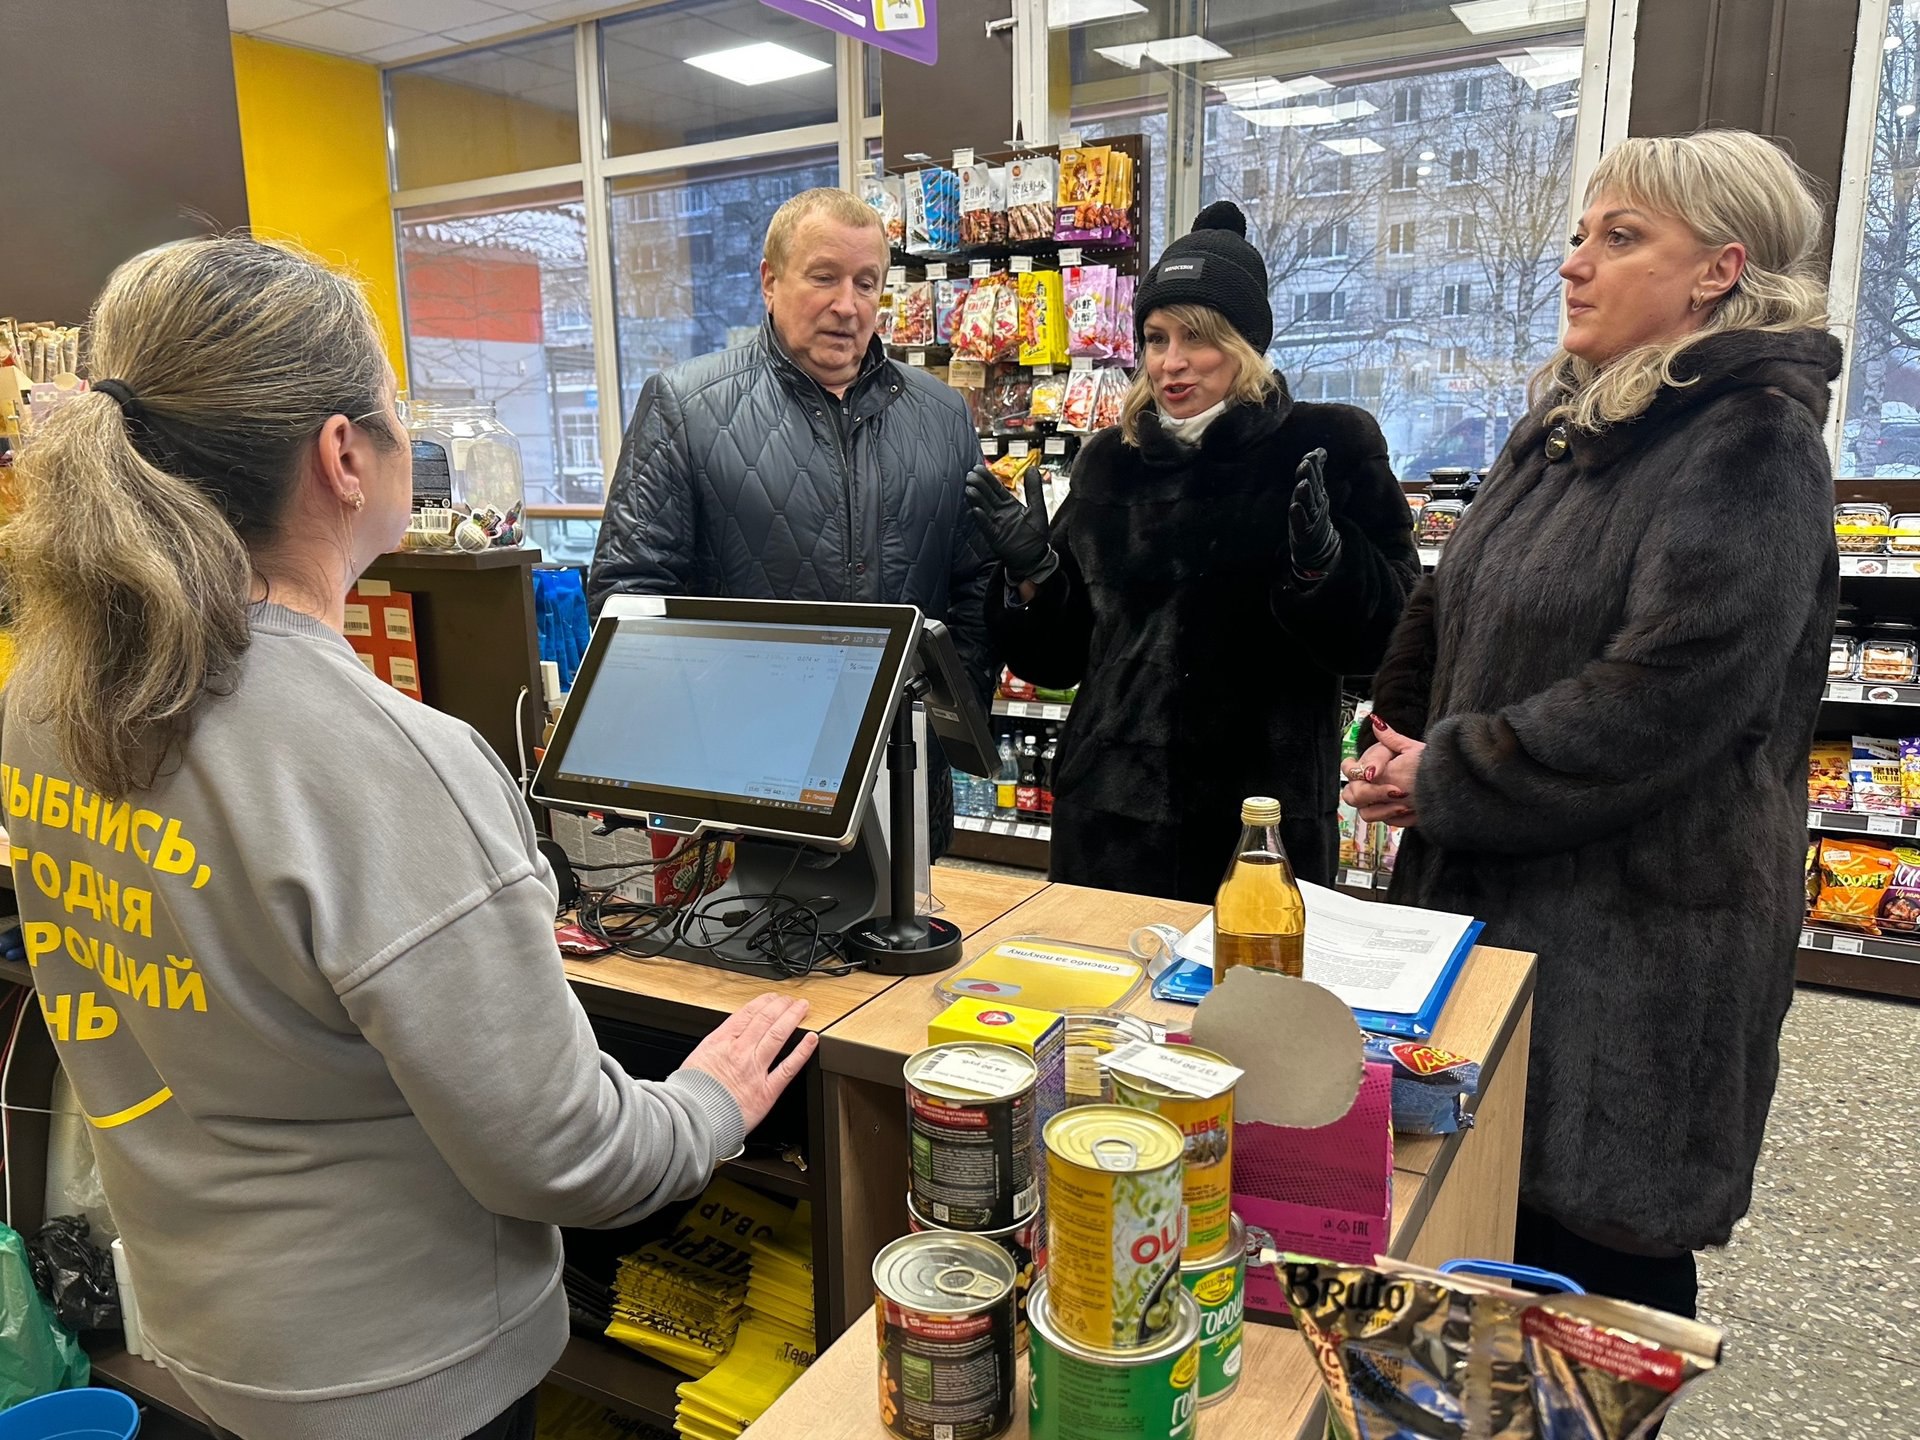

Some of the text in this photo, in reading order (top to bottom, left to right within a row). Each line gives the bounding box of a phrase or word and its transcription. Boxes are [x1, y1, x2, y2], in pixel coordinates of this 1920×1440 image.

[1007, 948, 1053, 961] покупку
[24, 921, 208, 1012] РОШИЙ
[1070, 959, 1120, 972] Спасибо
